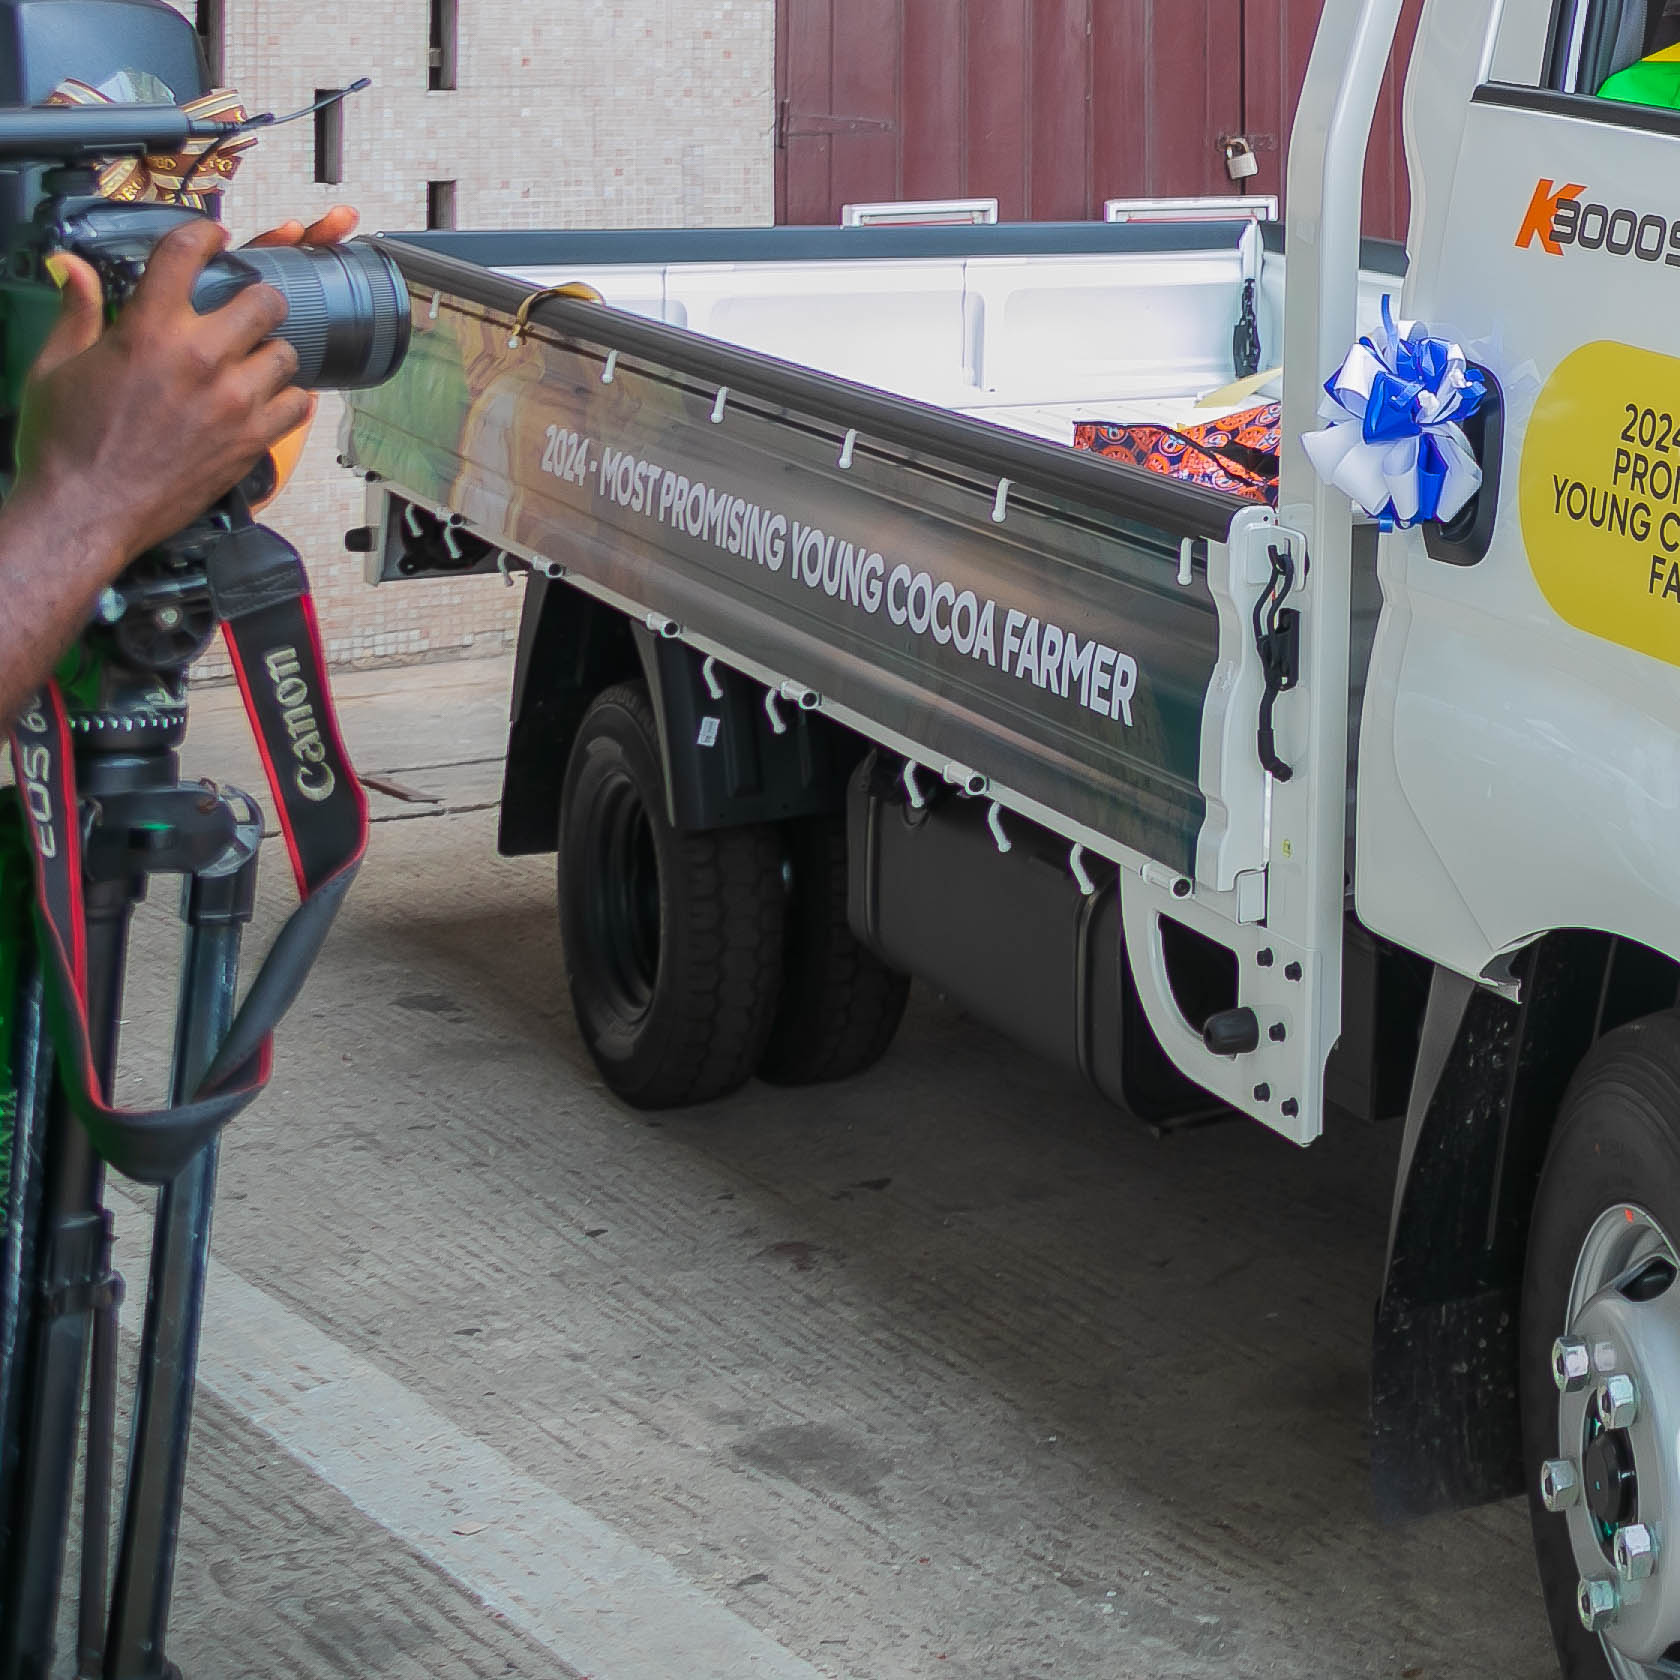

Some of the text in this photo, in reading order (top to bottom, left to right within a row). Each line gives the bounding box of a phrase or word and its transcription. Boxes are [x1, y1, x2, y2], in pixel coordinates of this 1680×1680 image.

[541, 423, 590, 487] 2024
[600, 447, 662, 517] MOST
[658, 471, 787, 571] PROMISING
[791, 521, 885, 614] YOUNG
[887, 563, 997, 667] COCOA
[1001, 608, 1138, 728] FARMER
[1552, 473, 1651, 543] YOUNG
[265, 647, 336, 802] Canon
[22, 744, 57, 859] EOS
